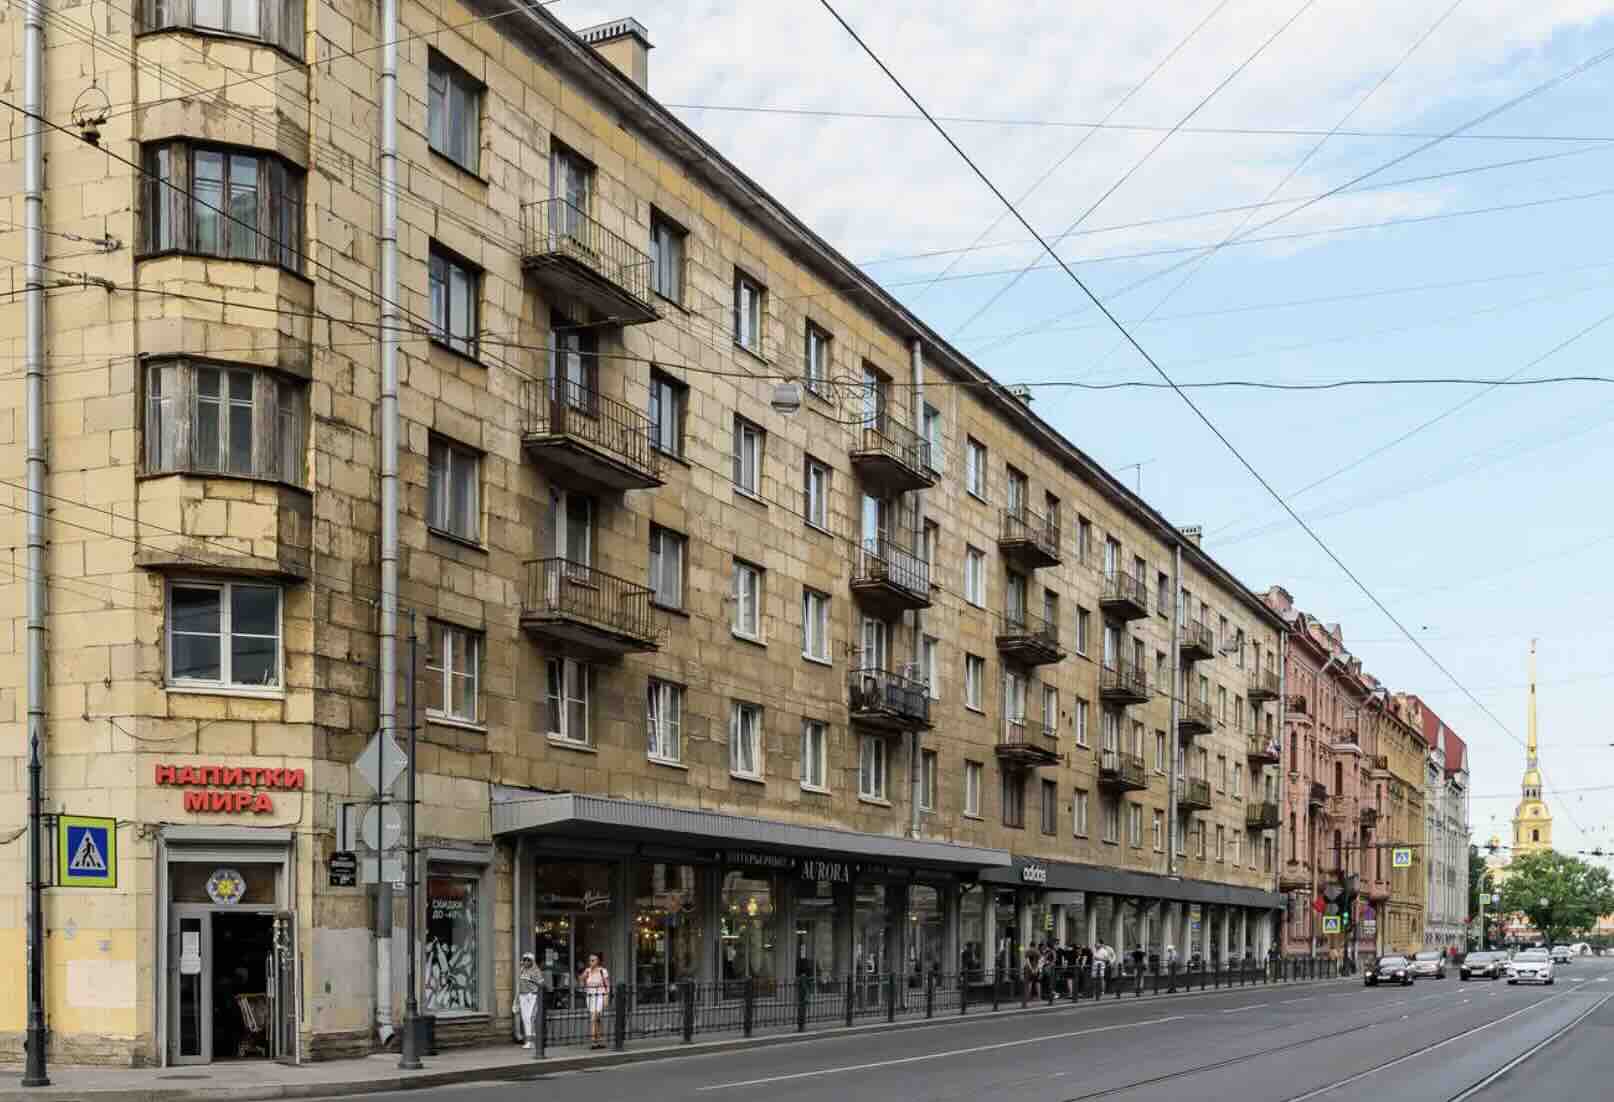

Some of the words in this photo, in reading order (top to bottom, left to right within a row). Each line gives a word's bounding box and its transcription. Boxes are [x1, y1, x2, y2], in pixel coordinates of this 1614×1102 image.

[155, 764, 304, 788] НАПИТКИ
[184, 790, 272, 813] МИРА
[801, 861, 849, 882] AURORA
[1023, 864, 1047, 882] adidas
